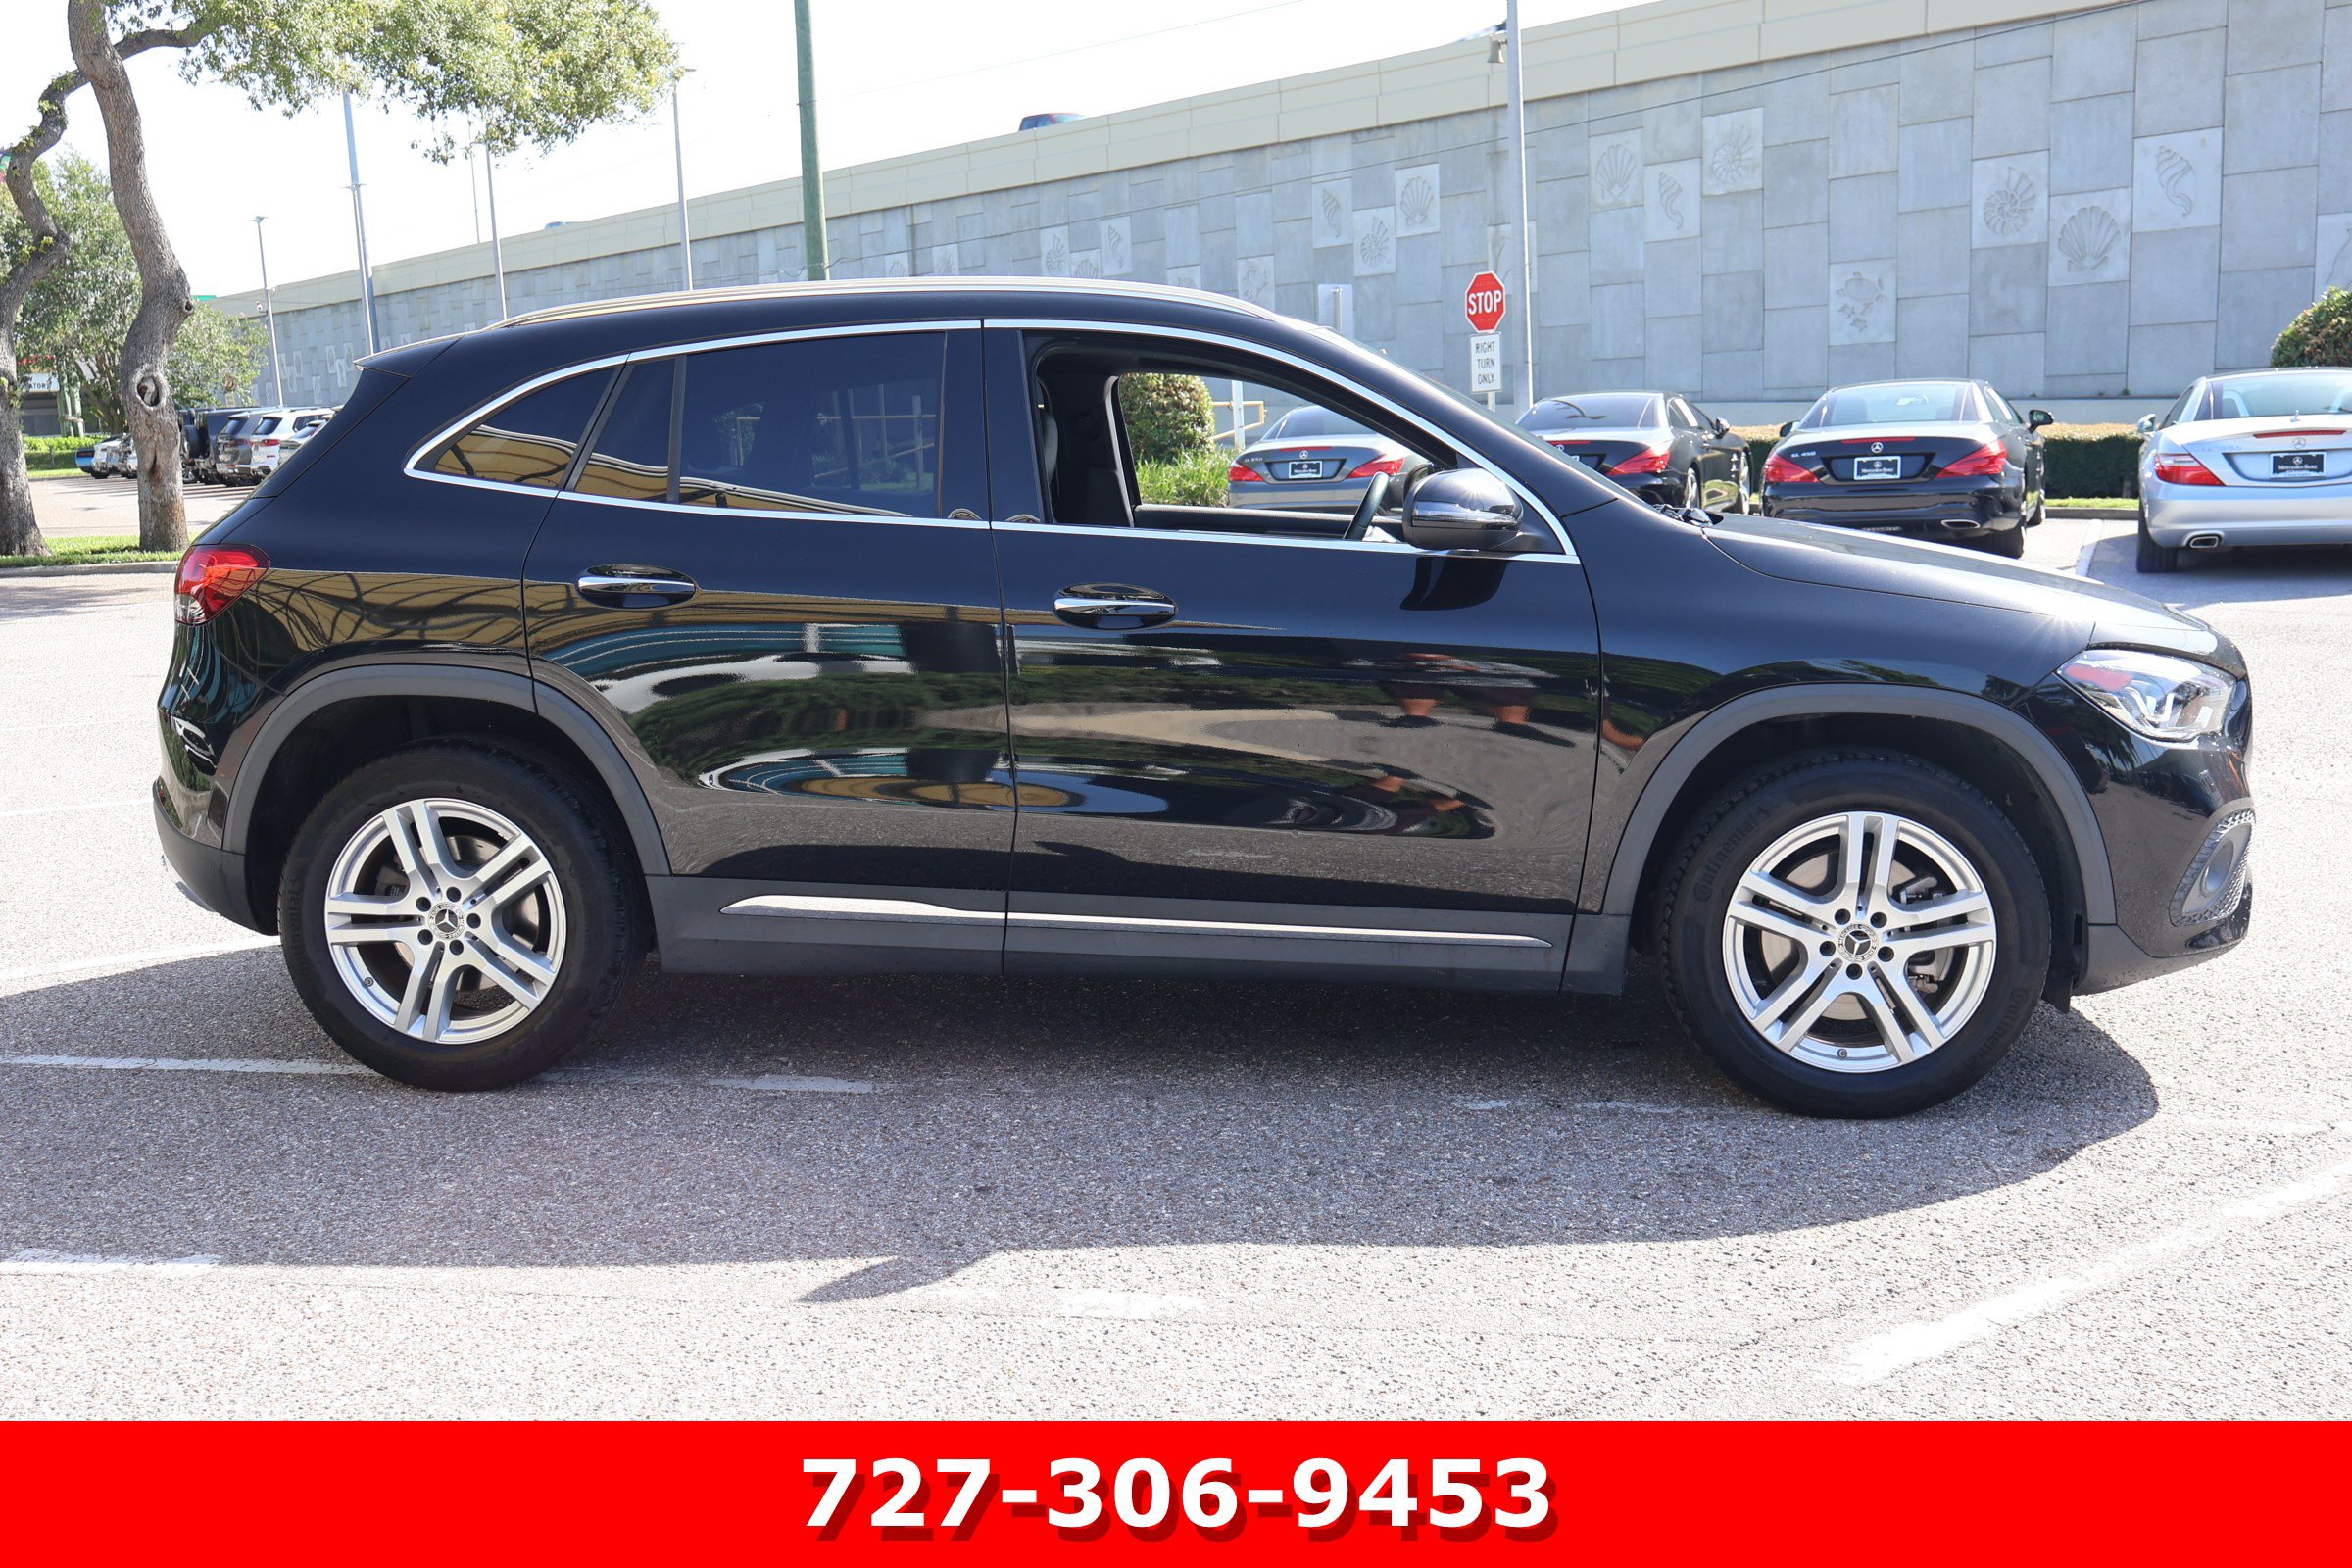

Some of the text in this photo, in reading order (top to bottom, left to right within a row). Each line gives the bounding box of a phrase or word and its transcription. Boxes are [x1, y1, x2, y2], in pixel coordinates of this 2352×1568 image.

[1468, 289, 1502, 316] STOP
[1475, 341, 1495, 354] RIGHT
[1477, 357, 1495, 369] TURN
[1477, 372, 1495, 385] ONLY
